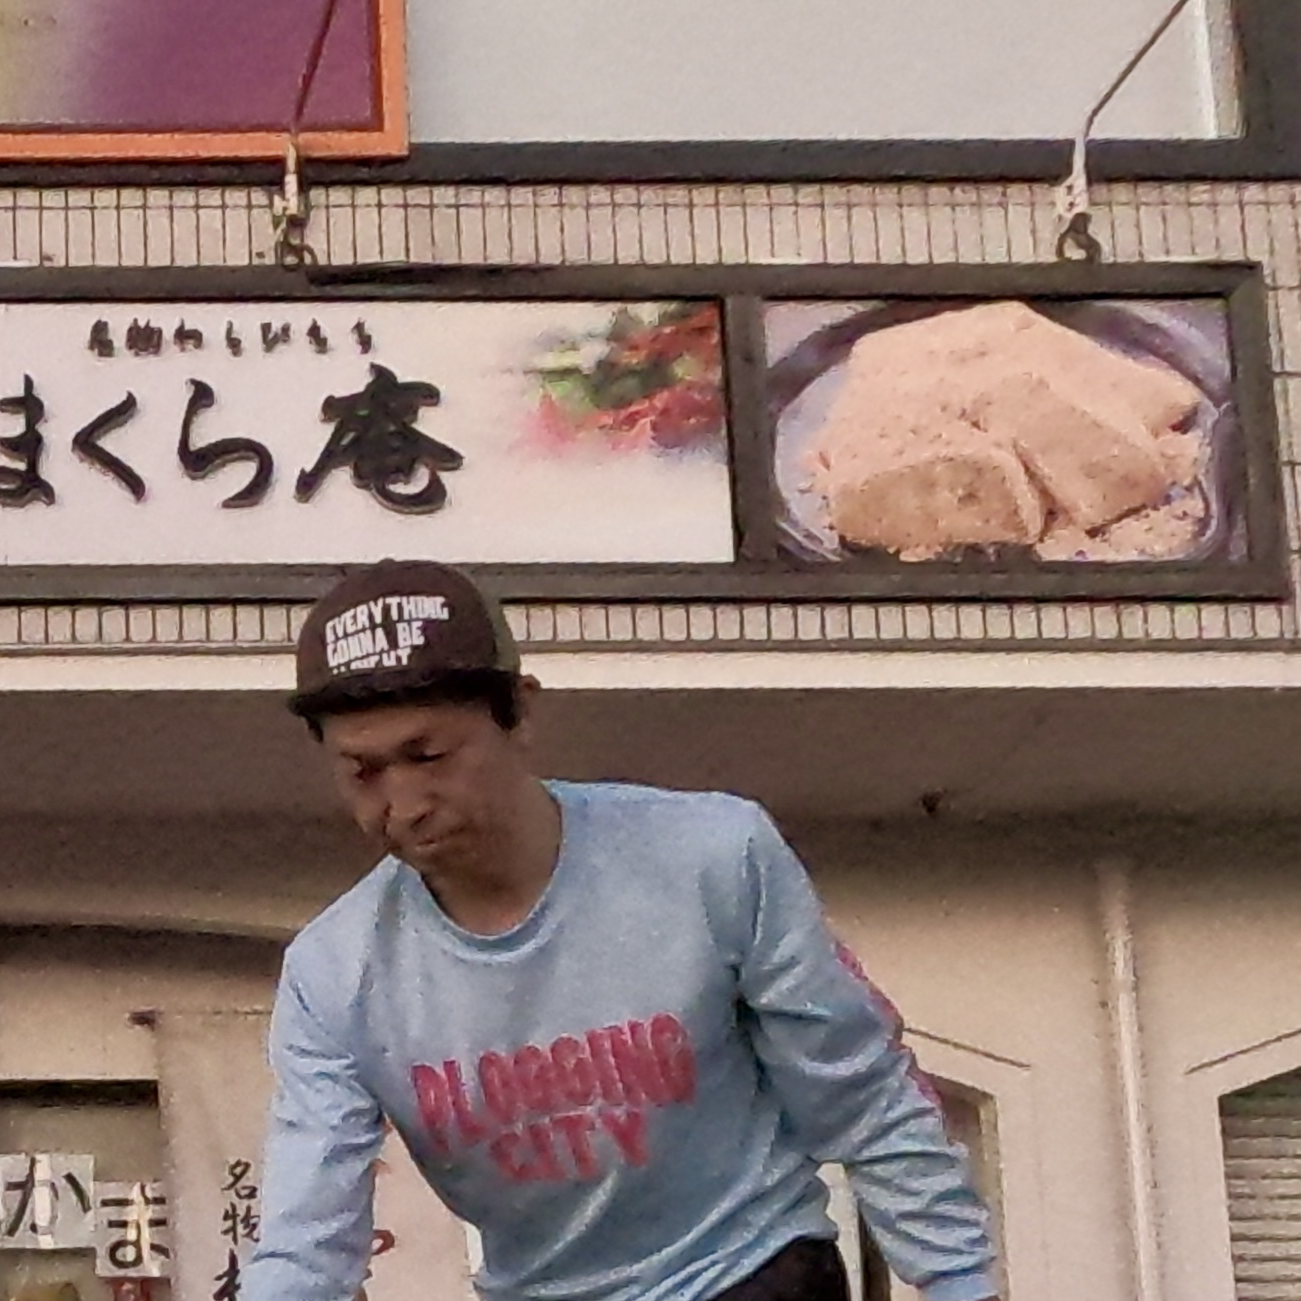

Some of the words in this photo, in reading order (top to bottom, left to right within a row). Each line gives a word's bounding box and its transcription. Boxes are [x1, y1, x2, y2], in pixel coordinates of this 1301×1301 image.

[325, 595, 450, 643] EVERYTHING
[326, 627, 389, 668] GONNA
[396, 620, 425, 648] BE
[489, 1108, 648, 1182] CITY
[3, 1155, 171, 1270] かま
